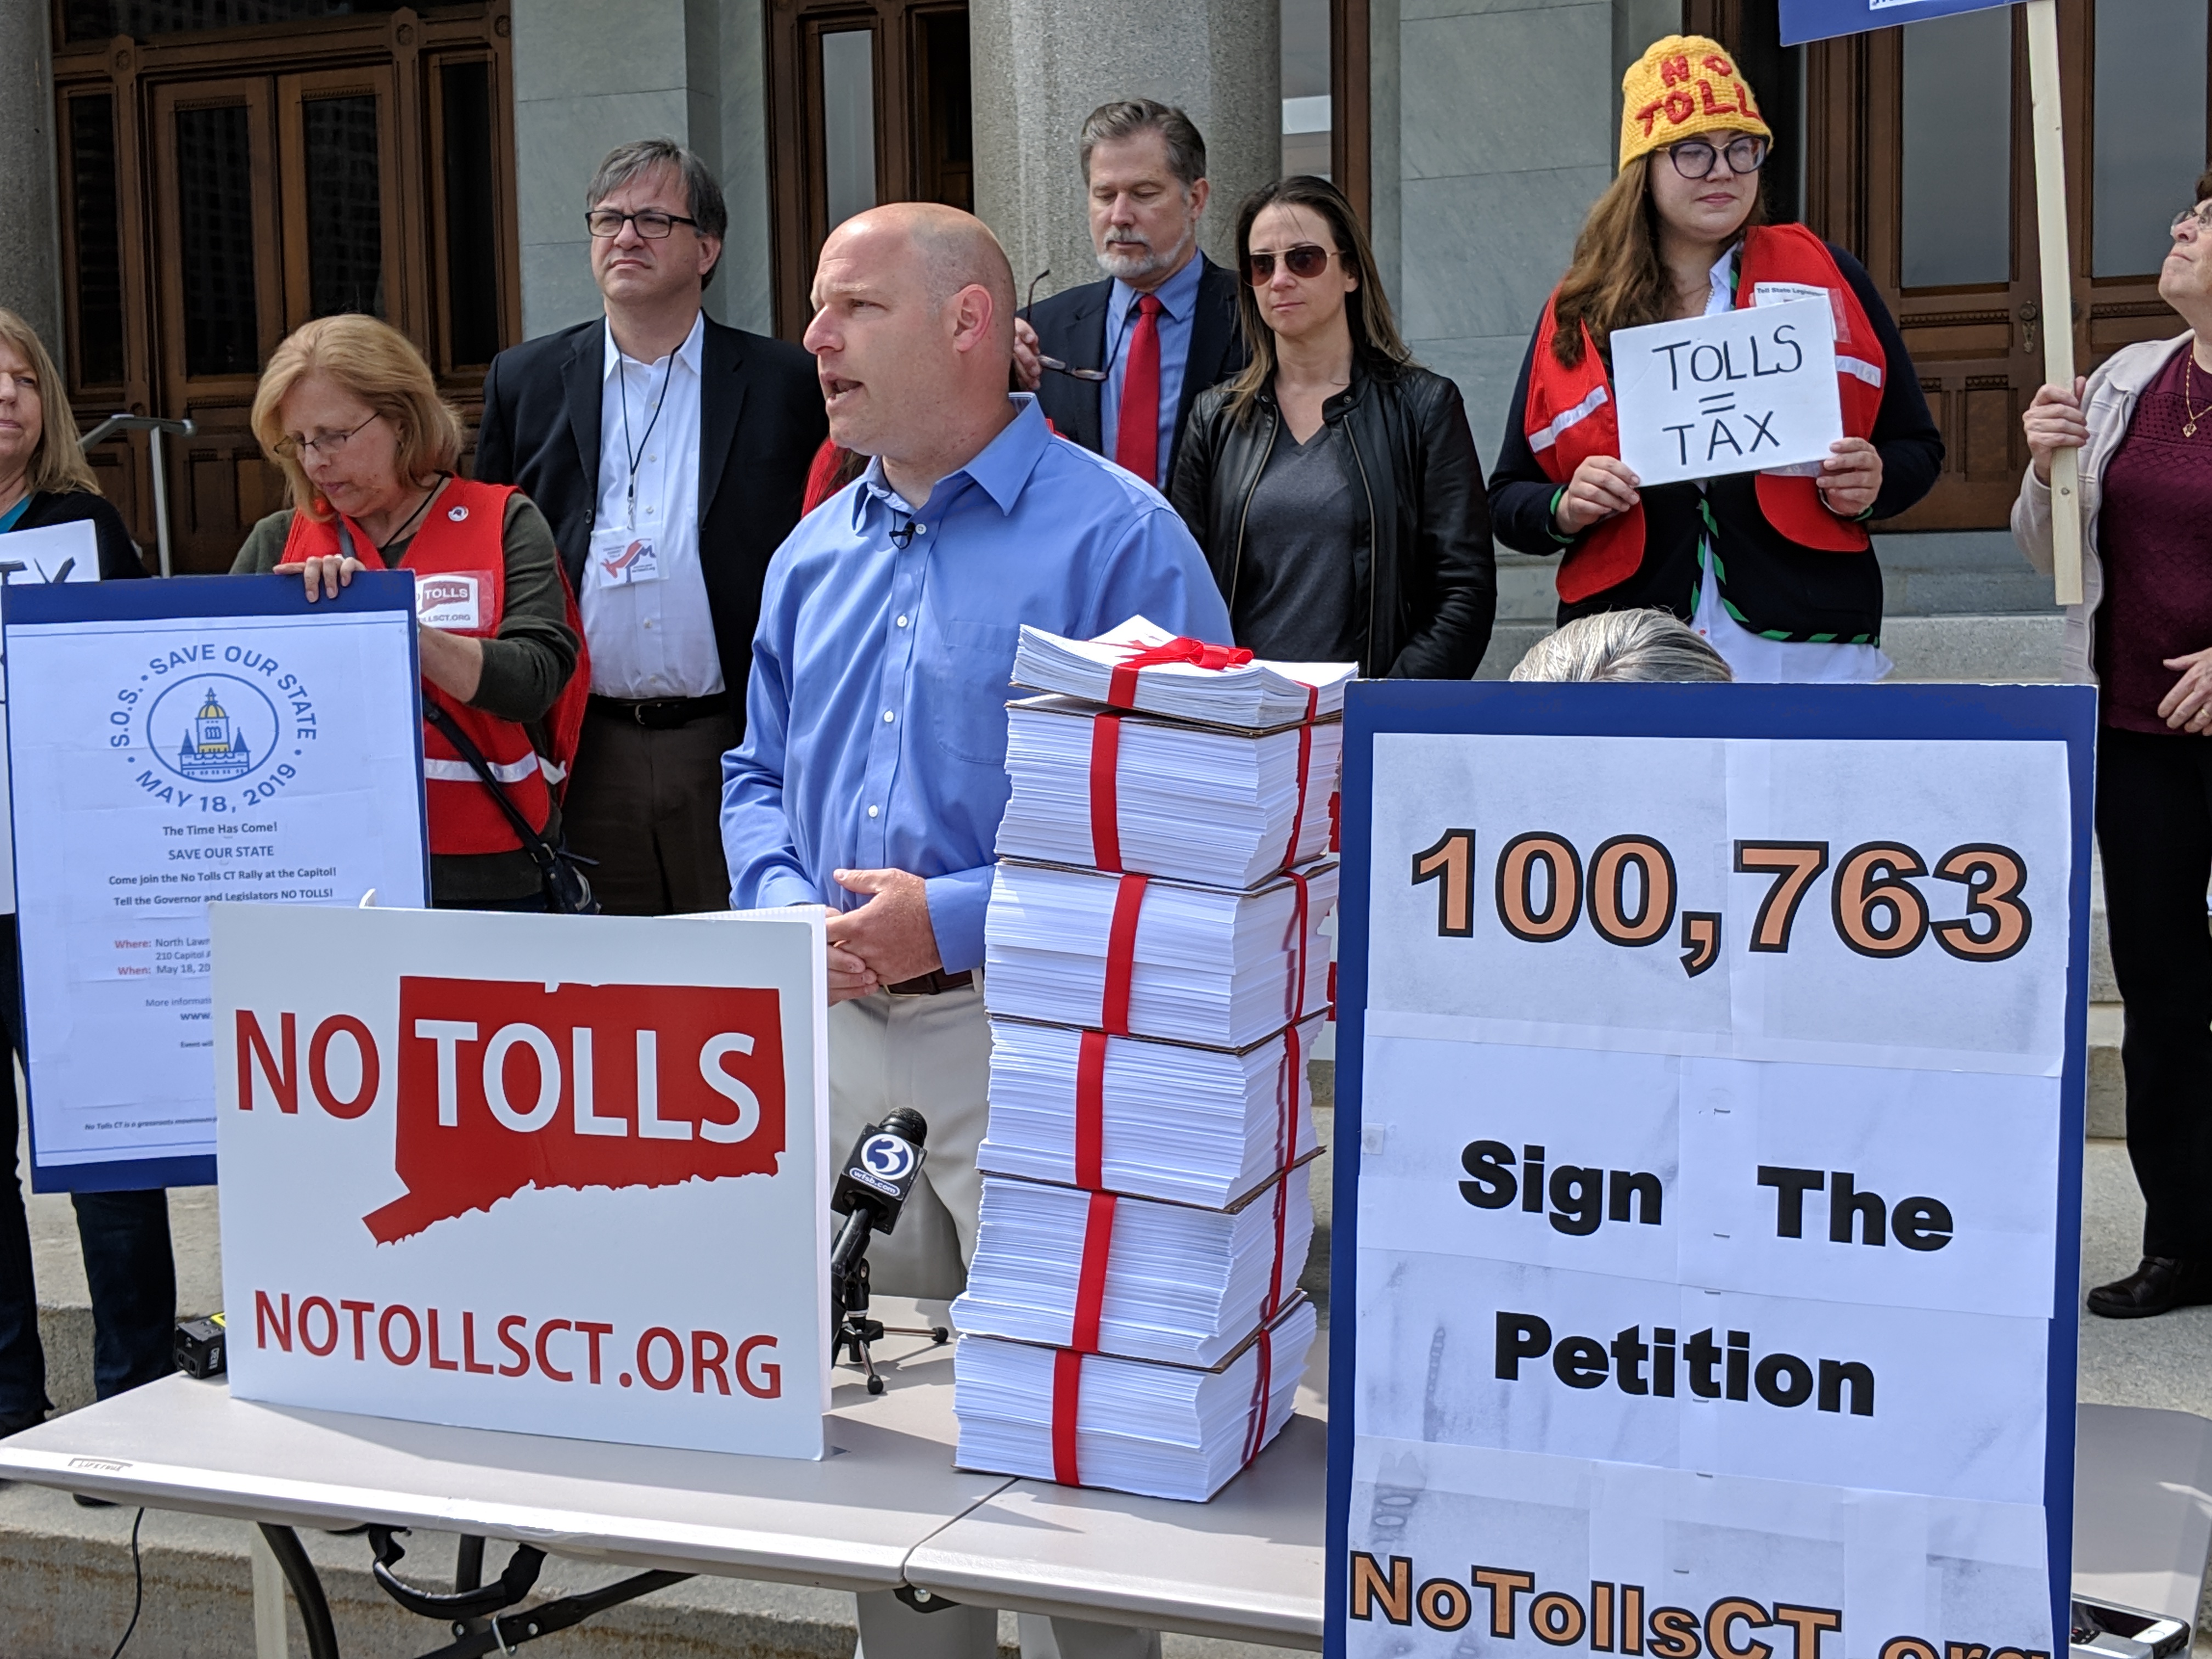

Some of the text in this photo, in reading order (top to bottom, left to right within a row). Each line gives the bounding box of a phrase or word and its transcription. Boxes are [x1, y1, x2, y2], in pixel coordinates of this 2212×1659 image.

[1660, 55, 1733, 88] NO
[1651, 325, 1802, 391] TOLLS
[1662, 410, 1780, 466] TAX
[425, 588, 468, 600] TOLLS
[149, 644, 317, 740] SAVE OUR STATE
[110, 688, 144, 748] S.O.S.
[135, 763, 296, 814] MAY 18, 2019
[163, 822, 277, 836] The Time Has Come!
[168, 845, 274, 860] SAVE OUR STATE
[109, 866, 337, 885] Come join the No Tolls CT Rally at the Capitol!
[114, 887, 334, 906] Tell the Governor and Legislators NO TOLLS!
[1412, 828, 2033, 978] 100,763
[115, 939, 151, 949] Where:
[156, 938, 183, 947] North
[156, 952, 172, 960] 210
[174, 950, 204, 960] Capitol
[118, 967, 151, 975] When:
[157, 964, 178, 975] May
[180, 964, 196, 973] 18,
[236, 1009, 760, 1144] NO TOLLS
[854, 1171, 896, 1194] wfsb.com
[1458, 1140, 1954, 1251] Sign The
[255, 1290, 782, 1400] NOTOLLSCT.ORG
[1494, 1311, 1875, 1417] Petition
[1350, 1550, 2050, 1659] NoTollsCT
